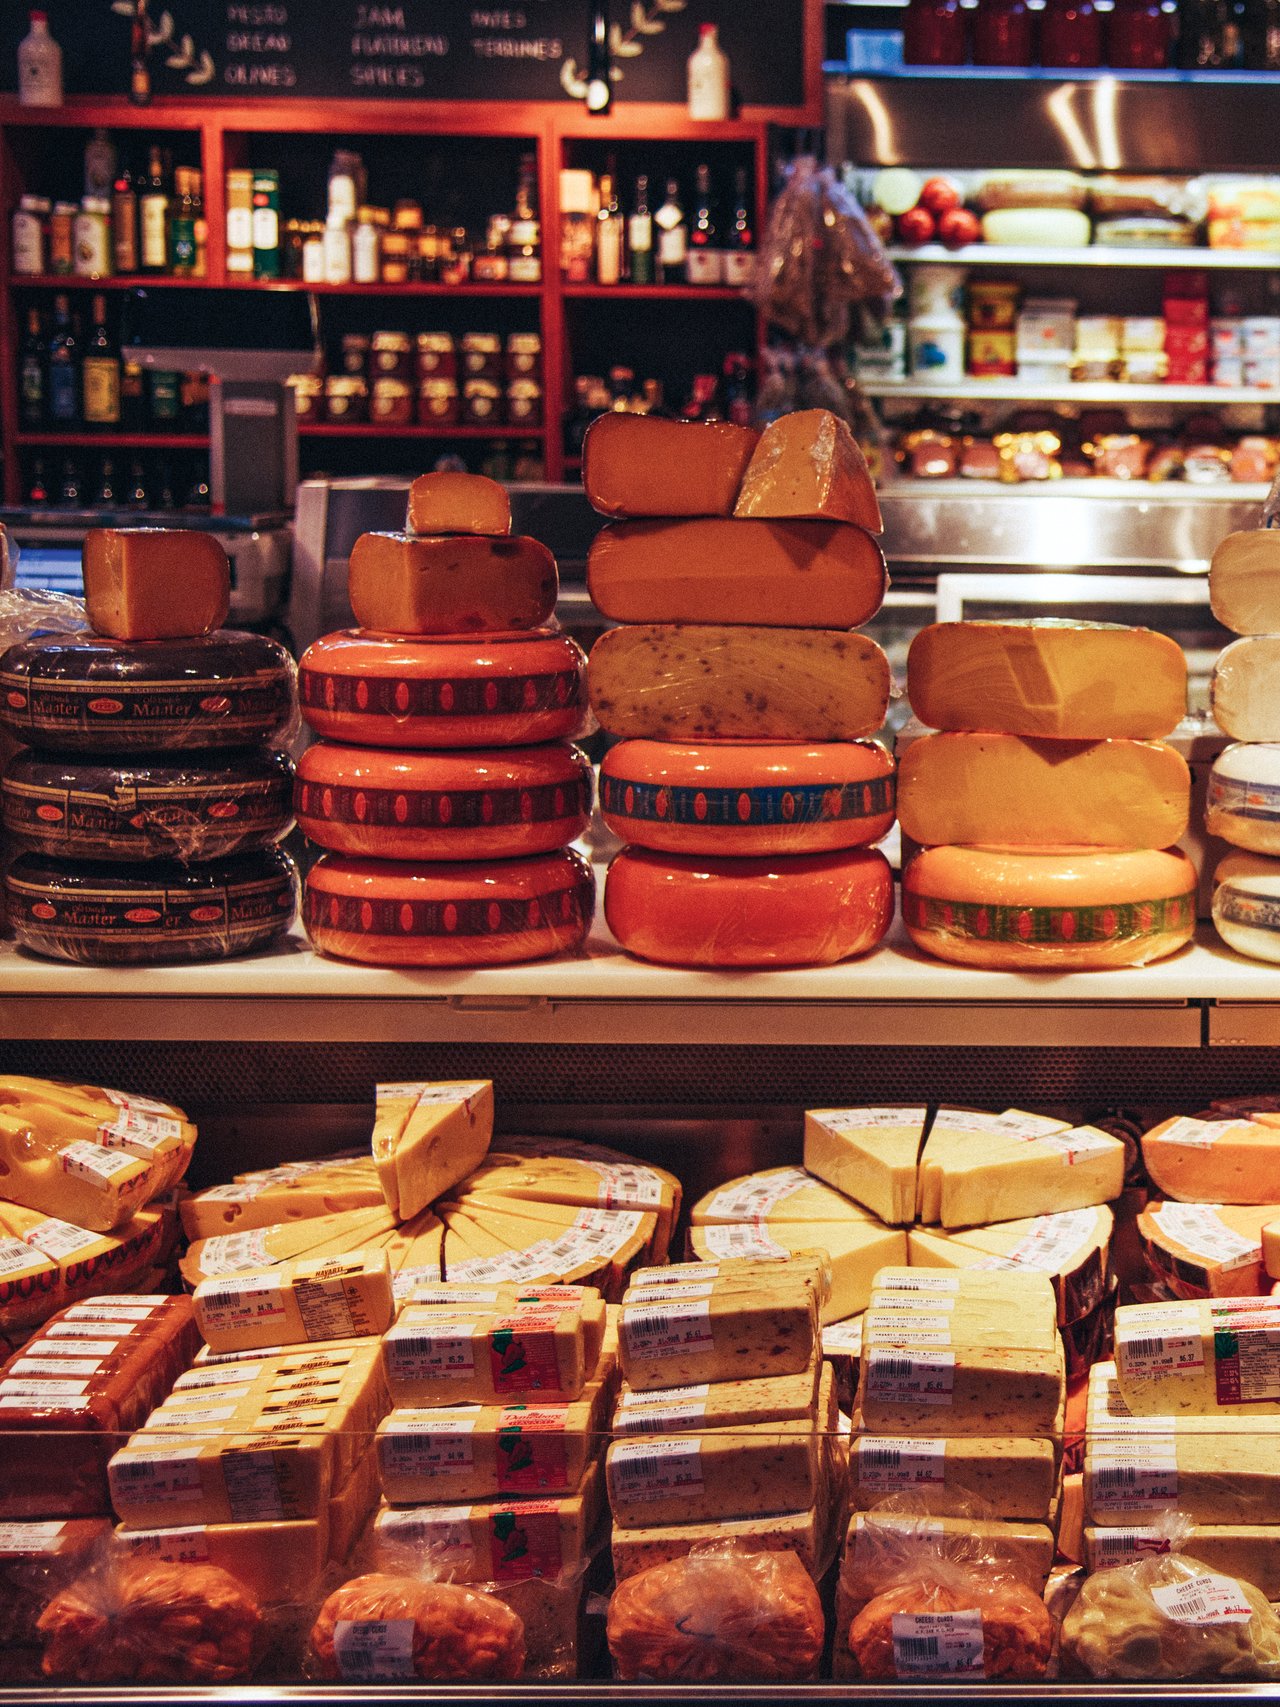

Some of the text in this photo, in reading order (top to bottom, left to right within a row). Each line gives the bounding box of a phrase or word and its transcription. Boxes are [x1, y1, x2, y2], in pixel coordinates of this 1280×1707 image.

[33, 700, 79, 716] Master
[132, 702, 192, 717] Master
[63, 911, 117, 925] Master
[315, 1266, 345, 1278] HAVARTI
[1180, 1354, 1195, 1362] $6.37
[1176, 1583, 1194, 1594] CHEESE
